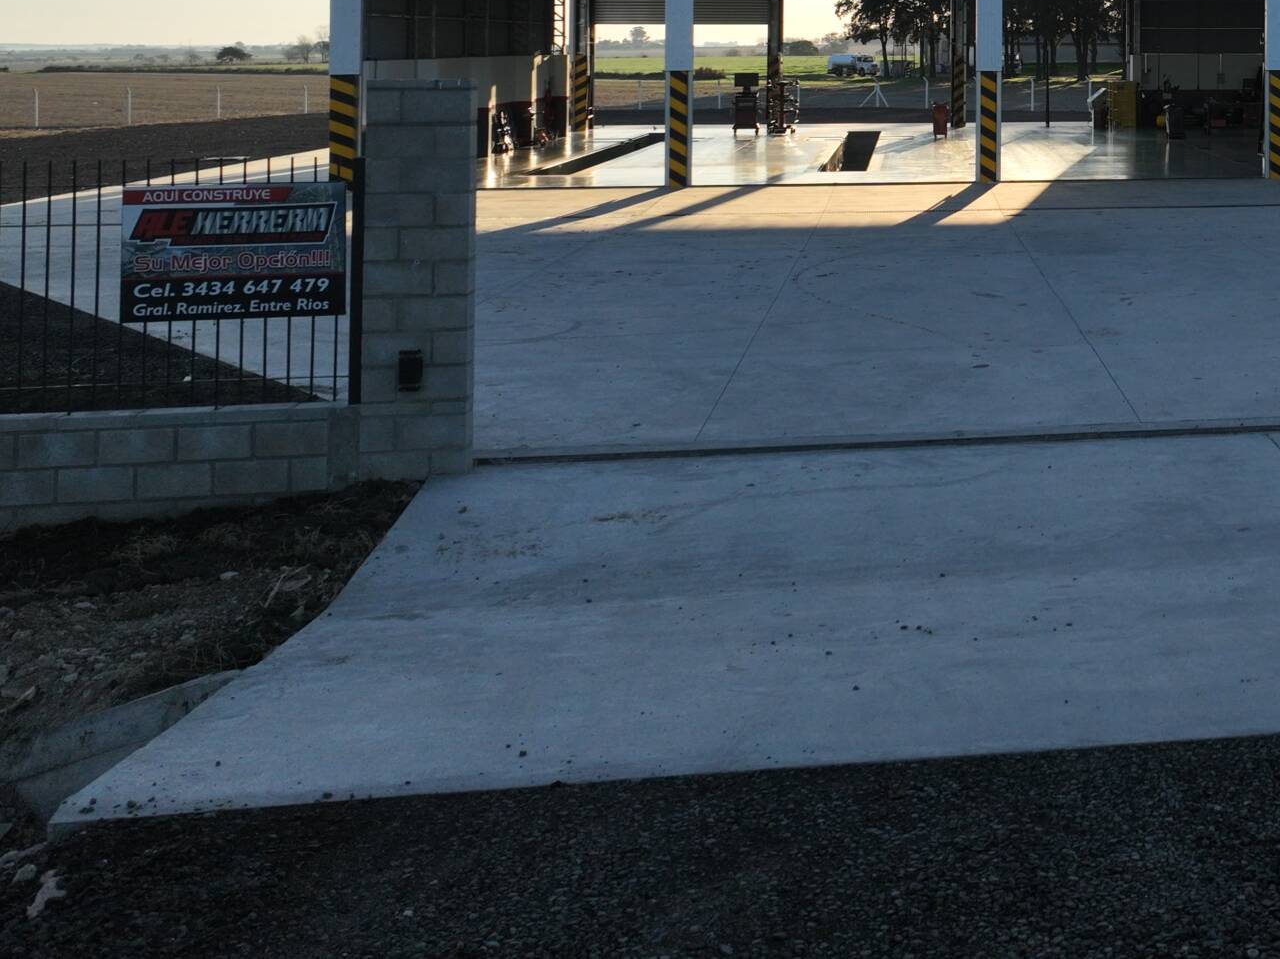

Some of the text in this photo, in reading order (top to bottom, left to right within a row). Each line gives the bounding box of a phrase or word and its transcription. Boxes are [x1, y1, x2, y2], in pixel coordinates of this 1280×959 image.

[182, 188, 272, 202] CONSTRUYE
[133, 248, 331, 274] Su Mejor Opción!!!
[133, 277, 330, 298] Cel. 3434 647 479
[132, 303, 172, 317] Gral.
[249, 299, 292, 313] Entre
